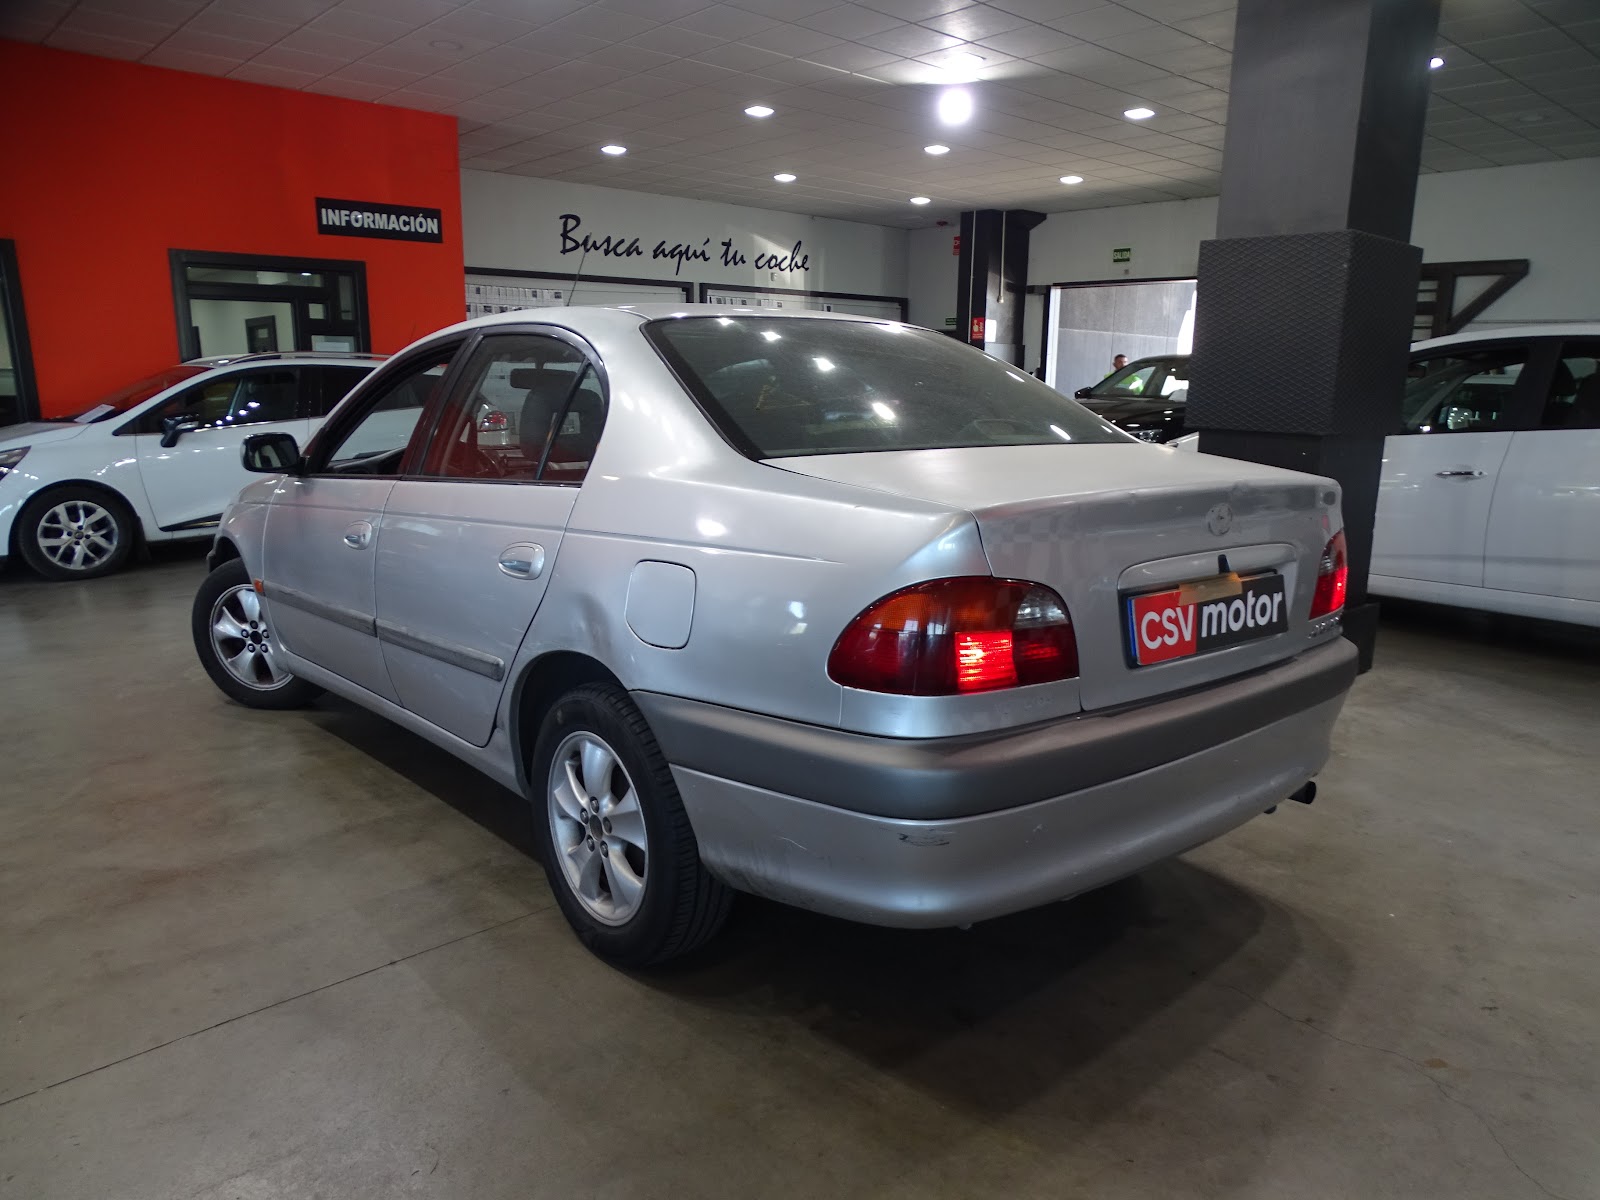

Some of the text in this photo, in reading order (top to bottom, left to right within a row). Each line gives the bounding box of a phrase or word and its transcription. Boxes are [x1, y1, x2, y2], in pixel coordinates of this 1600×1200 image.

[321, 208, 439, 234] INFORMACIÓN
[559, 213, 810, 275] Busca aquí tu coche
[1113, 250, 1130, 260] SALIDA
[1140, 604, 1195, 650] CSV
[1201, 590, 1283, 639] motor
